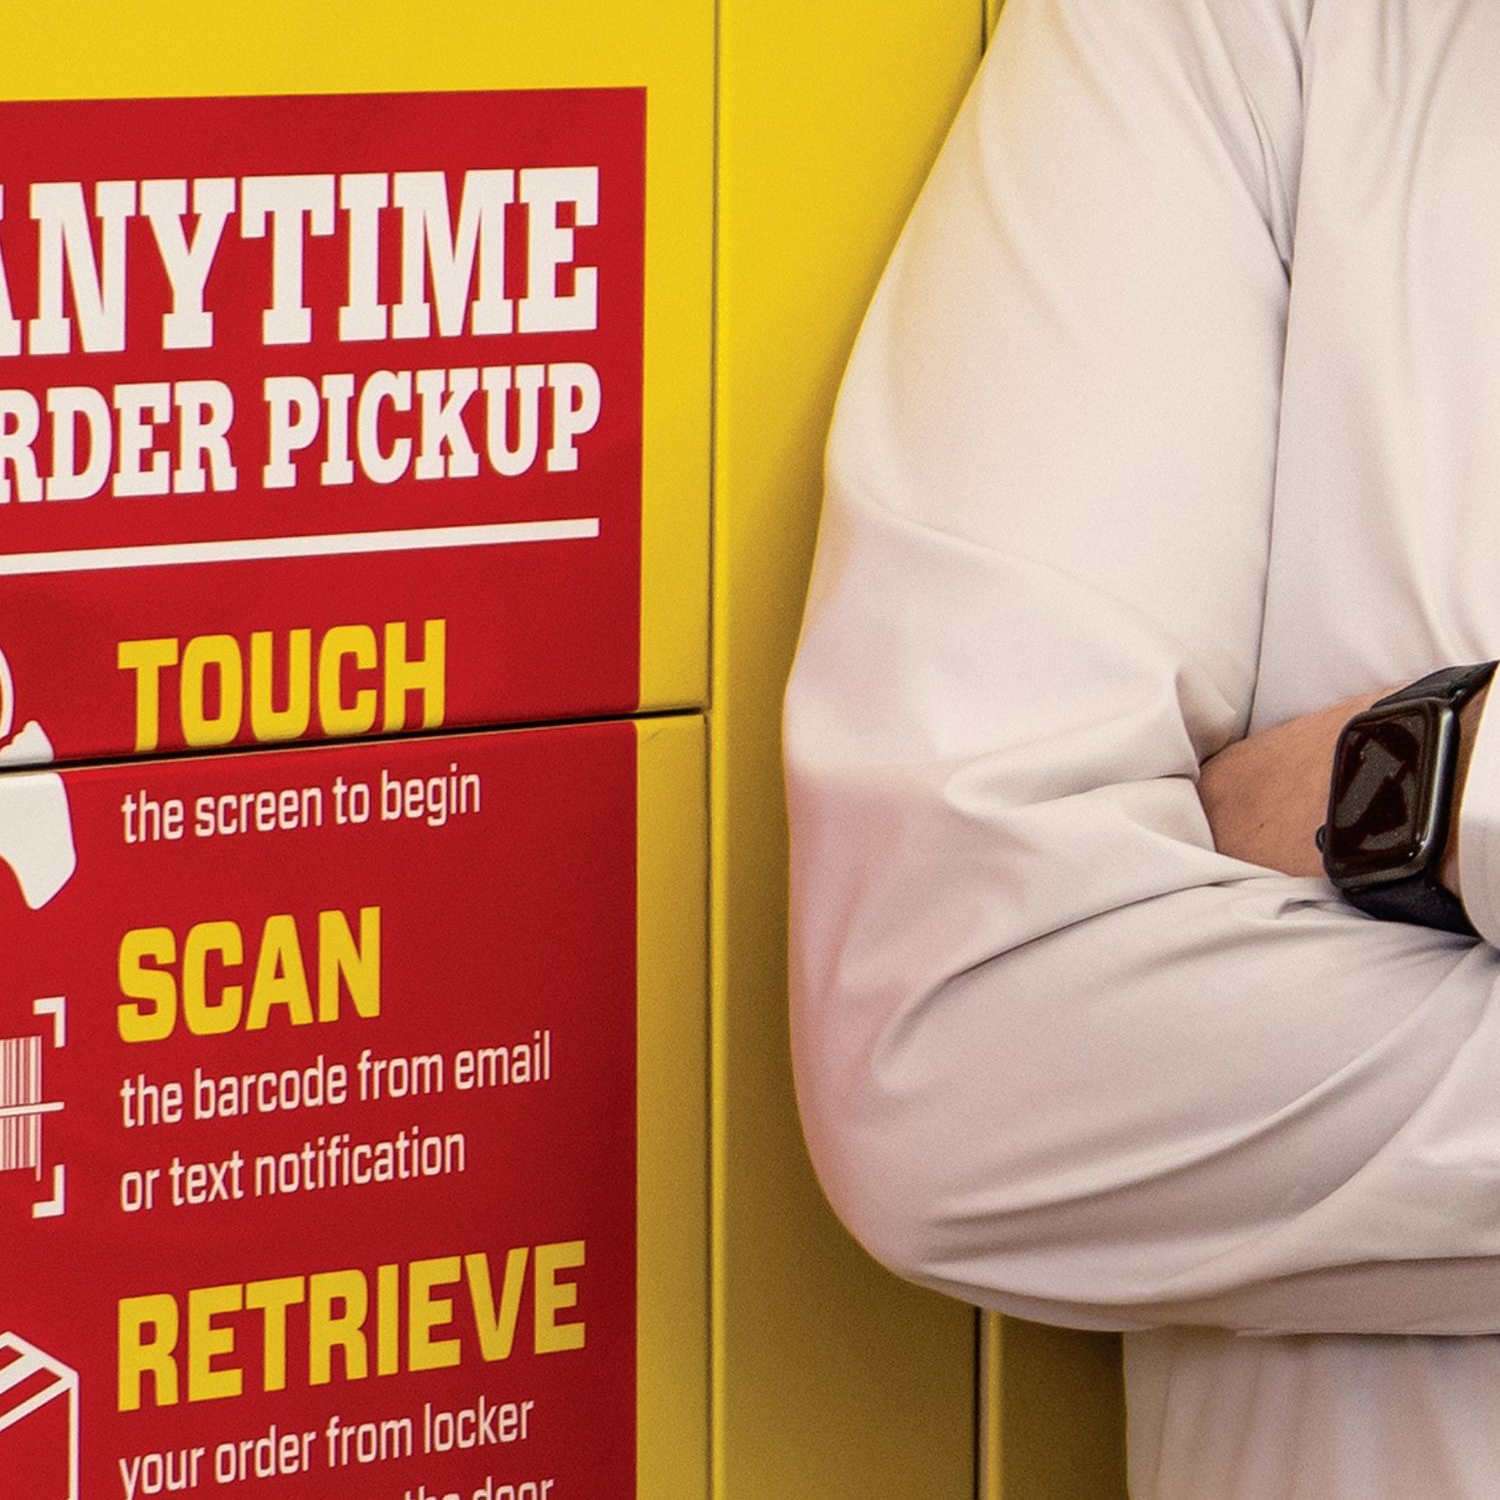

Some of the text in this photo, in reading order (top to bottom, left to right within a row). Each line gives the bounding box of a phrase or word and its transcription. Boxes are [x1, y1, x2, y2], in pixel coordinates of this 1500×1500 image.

[0, 165, 600, 357] NYTIME
[262, 362, 601, 489] PICKUP
[117, 619, 446, 752] TOUCH
[121, 763, 481, 843] the screen to begin
[117, 906, 381, 1043] SCAN
[119, 1029, 551, 1128] the barcode from email
[120, 1125, 466, 1212] or text notification
[117, 1240, 586, 1412] RETRIEVE
[118, 1395, 535, 1500] your order from locker
